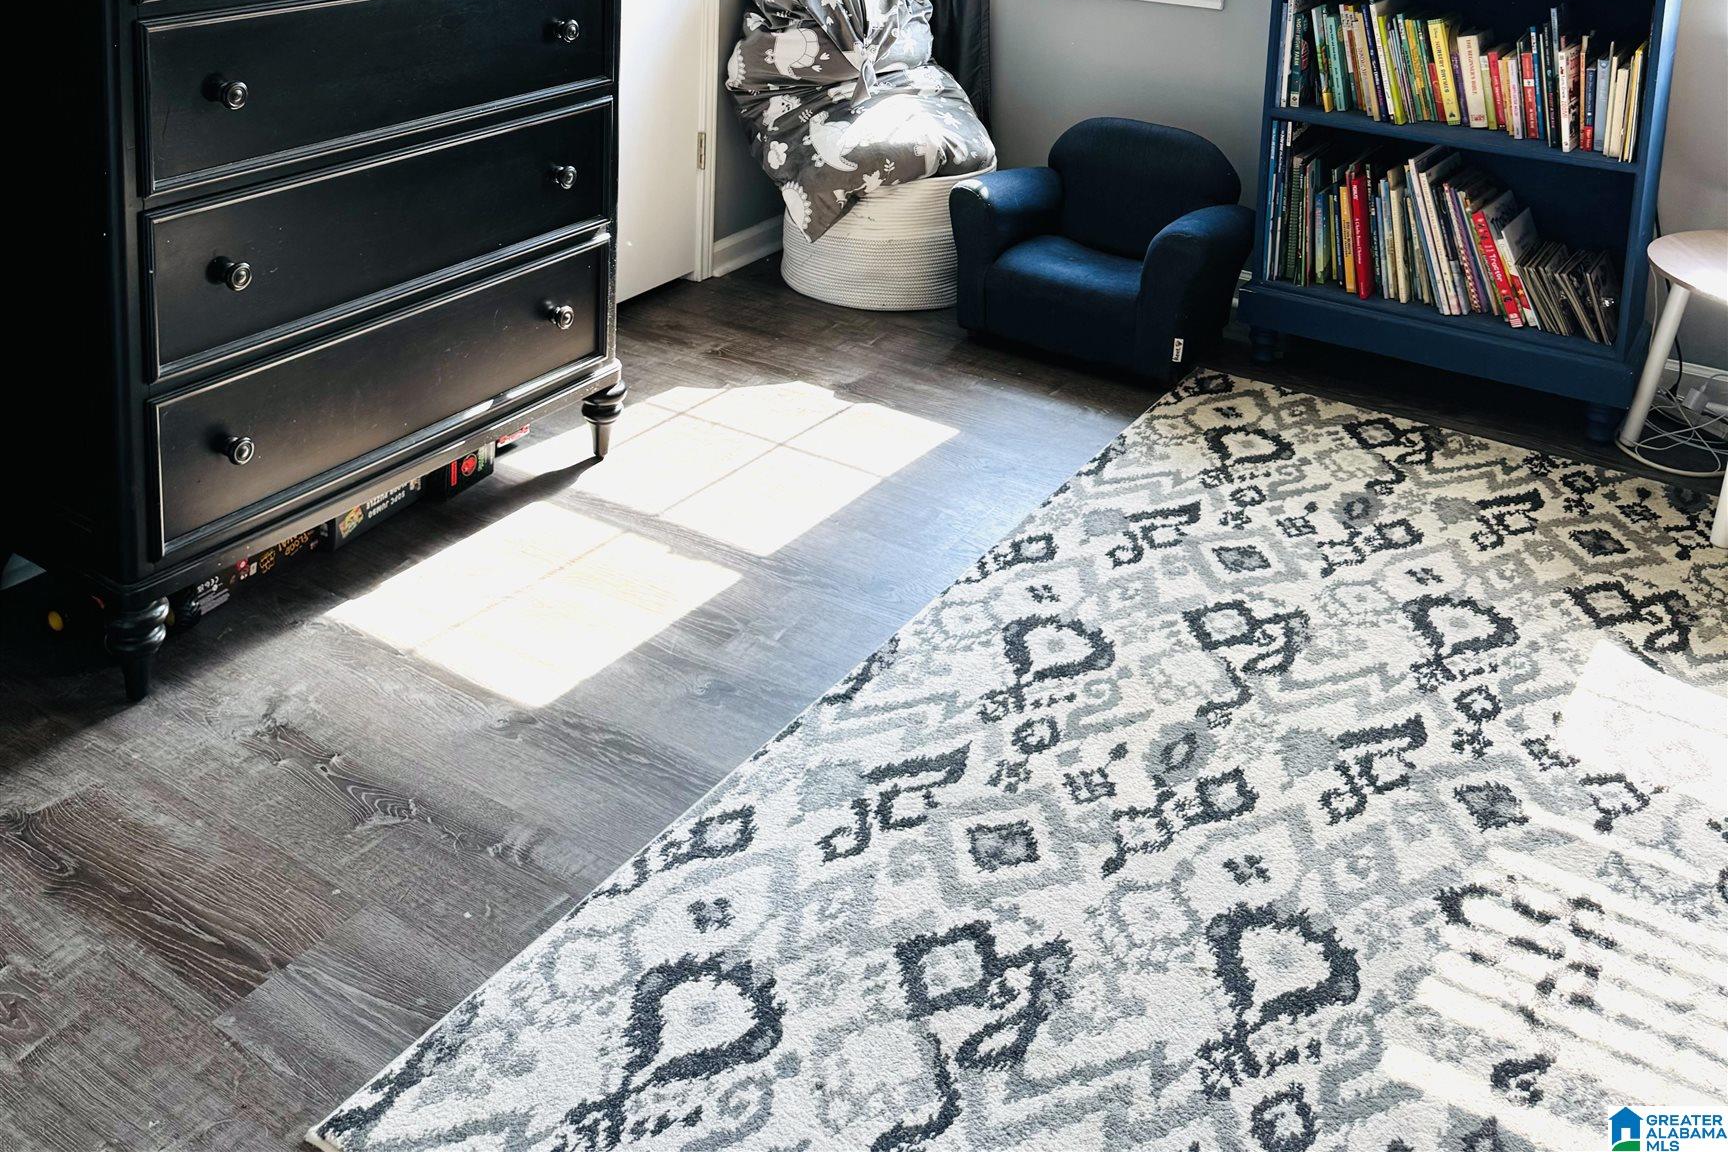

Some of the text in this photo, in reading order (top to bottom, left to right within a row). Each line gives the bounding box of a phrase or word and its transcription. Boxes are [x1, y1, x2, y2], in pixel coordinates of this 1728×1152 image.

[1436, 41, 1444, 68] NURSERY
[1441, 70, 1450, 93] RHYMES
[1488, 254, 1503, 282] Tractor
[366, 491, 388, 510] PUZZLE
[368, 500, 390, 518] JUMBO
[284, 532, 309, 556] FLOOR
